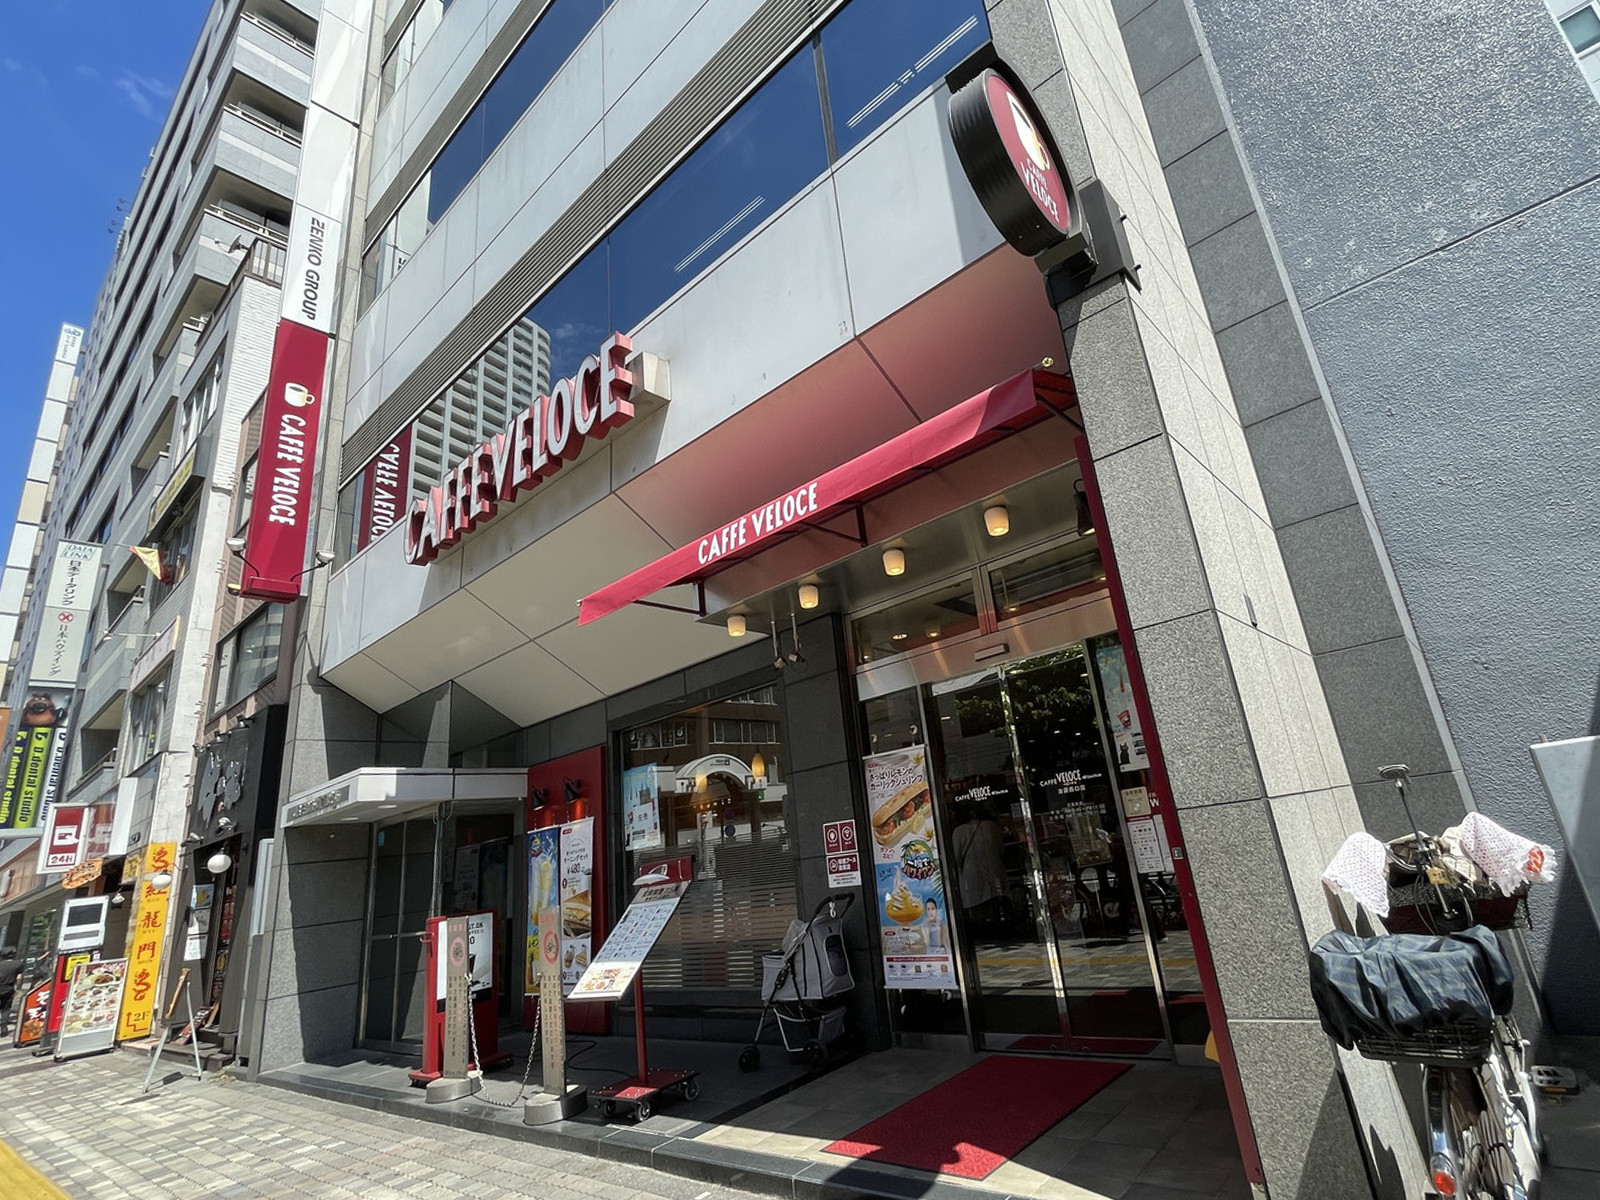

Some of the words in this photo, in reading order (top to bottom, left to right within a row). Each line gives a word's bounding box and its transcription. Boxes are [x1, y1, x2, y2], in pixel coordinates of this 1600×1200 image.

[1020, 161, 1060, 222] VELOCE
[306, 216, 326, 267] ZENKO
[301, 269, 321, 321] GROUP
[491, 331, 635, 503] VELOCE
[269, 467, 301, 527] VELOCE
[751, 482, 818, 537] VELOCE
[968, 785, 991, 799] VELOCE
[1055, 769, 1082, 784] VELOCE
[18, 789, 34, 823] studio
[50, 854, 74, 866] 24H
[133, 1012, 150, 1023] 2F
